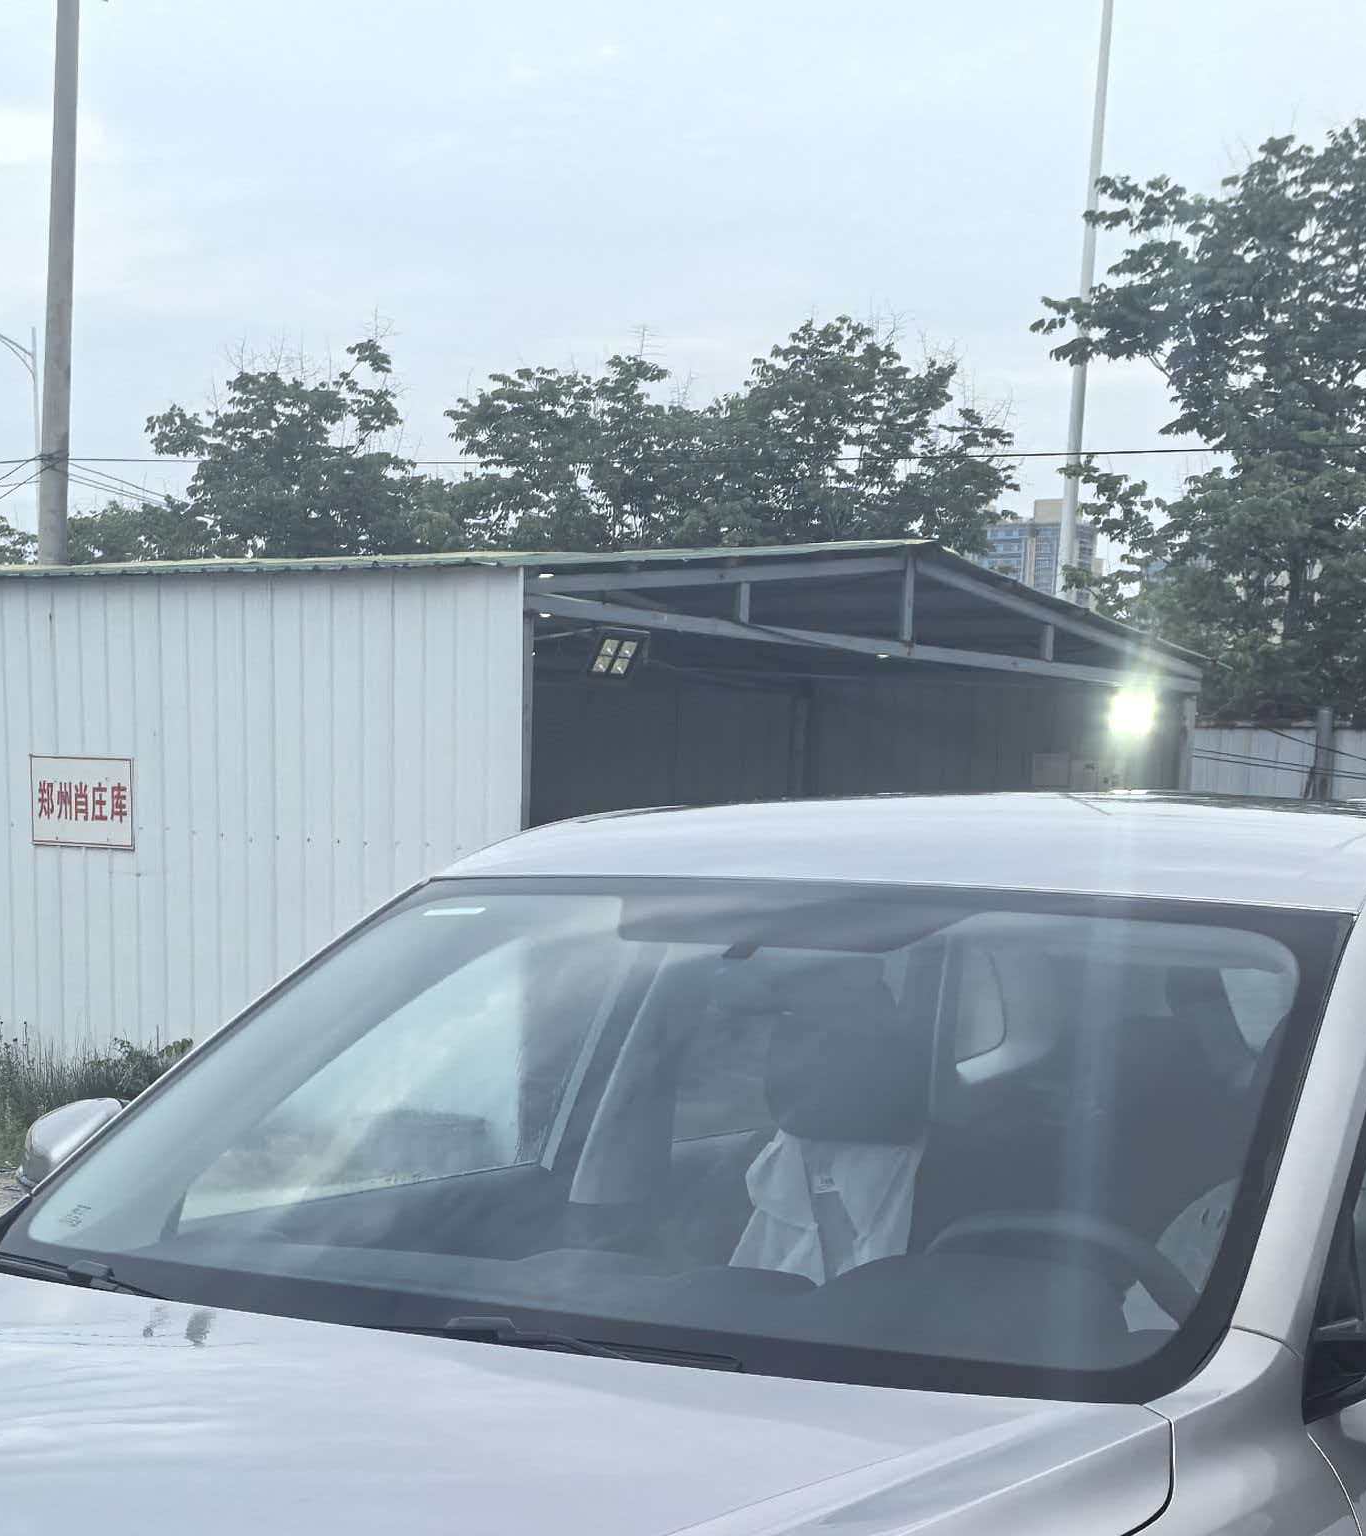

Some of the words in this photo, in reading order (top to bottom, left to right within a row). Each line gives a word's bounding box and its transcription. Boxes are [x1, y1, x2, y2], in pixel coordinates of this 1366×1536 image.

[38, 780, 128, 824] 郑州肖庄库
